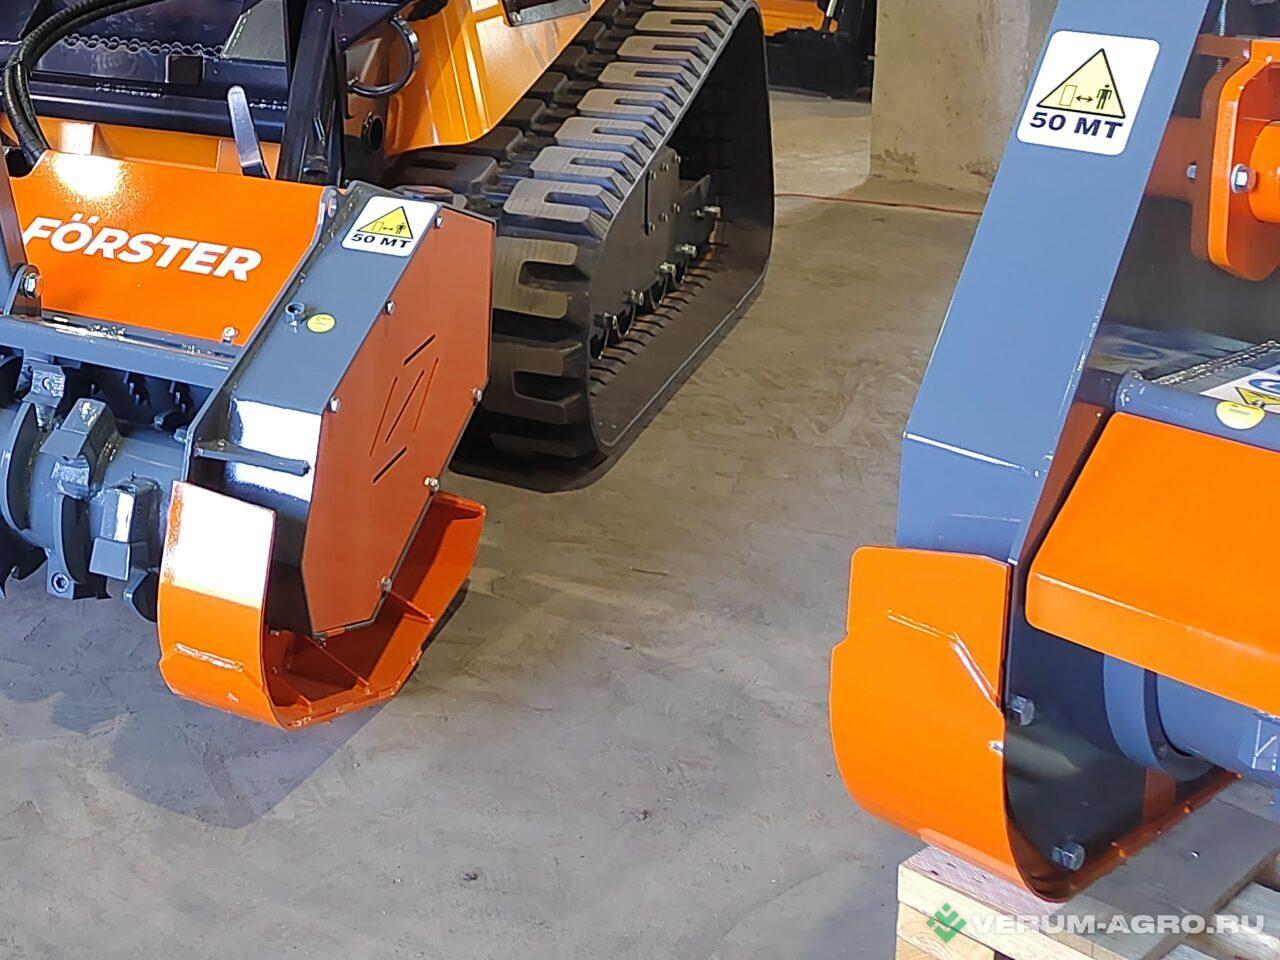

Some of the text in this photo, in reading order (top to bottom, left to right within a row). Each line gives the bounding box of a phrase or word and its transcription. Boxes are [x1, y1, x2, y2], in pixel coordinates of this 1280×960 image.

[1029, 111, 1124, 139] 50 MT
[22, 212, 263, 282] FÖRSTER
[351, 233, 412, 249] 50 MT
